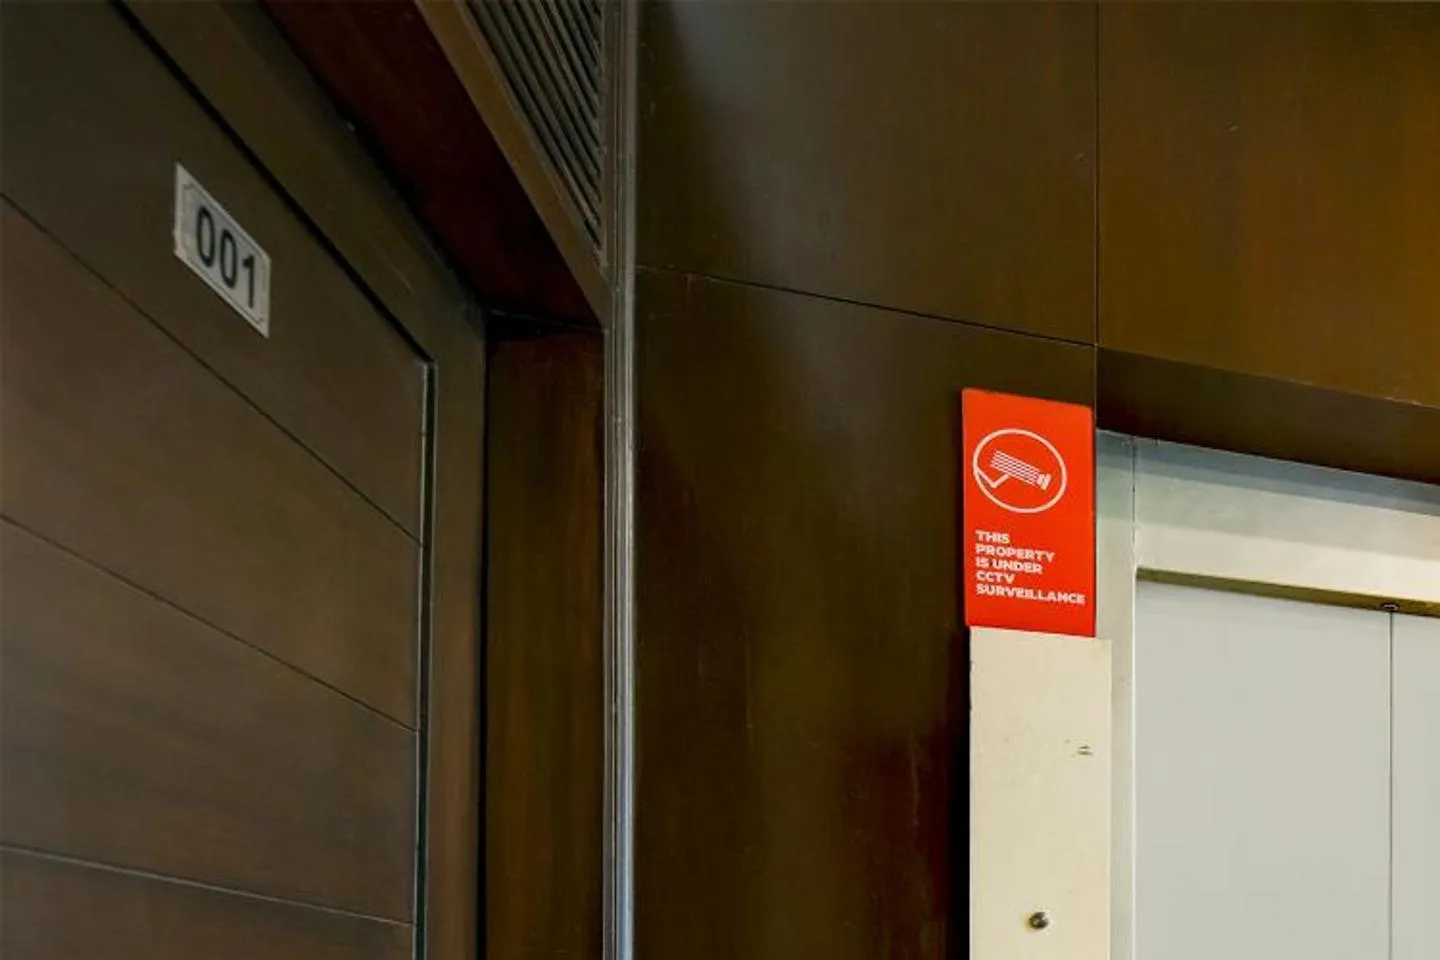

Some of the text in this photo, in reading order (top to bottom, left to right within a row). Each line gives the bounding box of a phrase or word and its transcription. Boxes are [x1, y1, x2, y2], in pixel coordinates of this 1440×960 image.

[196, 205, 255, 309] 001
[975, 529, 1010, 544] THIS
[975, 542, 1055, 563] PROPERTY
[975, 556, 1043, 575] IS UNDER
[975, 570, 1016, 584] CCTV
[976, 583, 1086, 605] SURVEILLANCE
